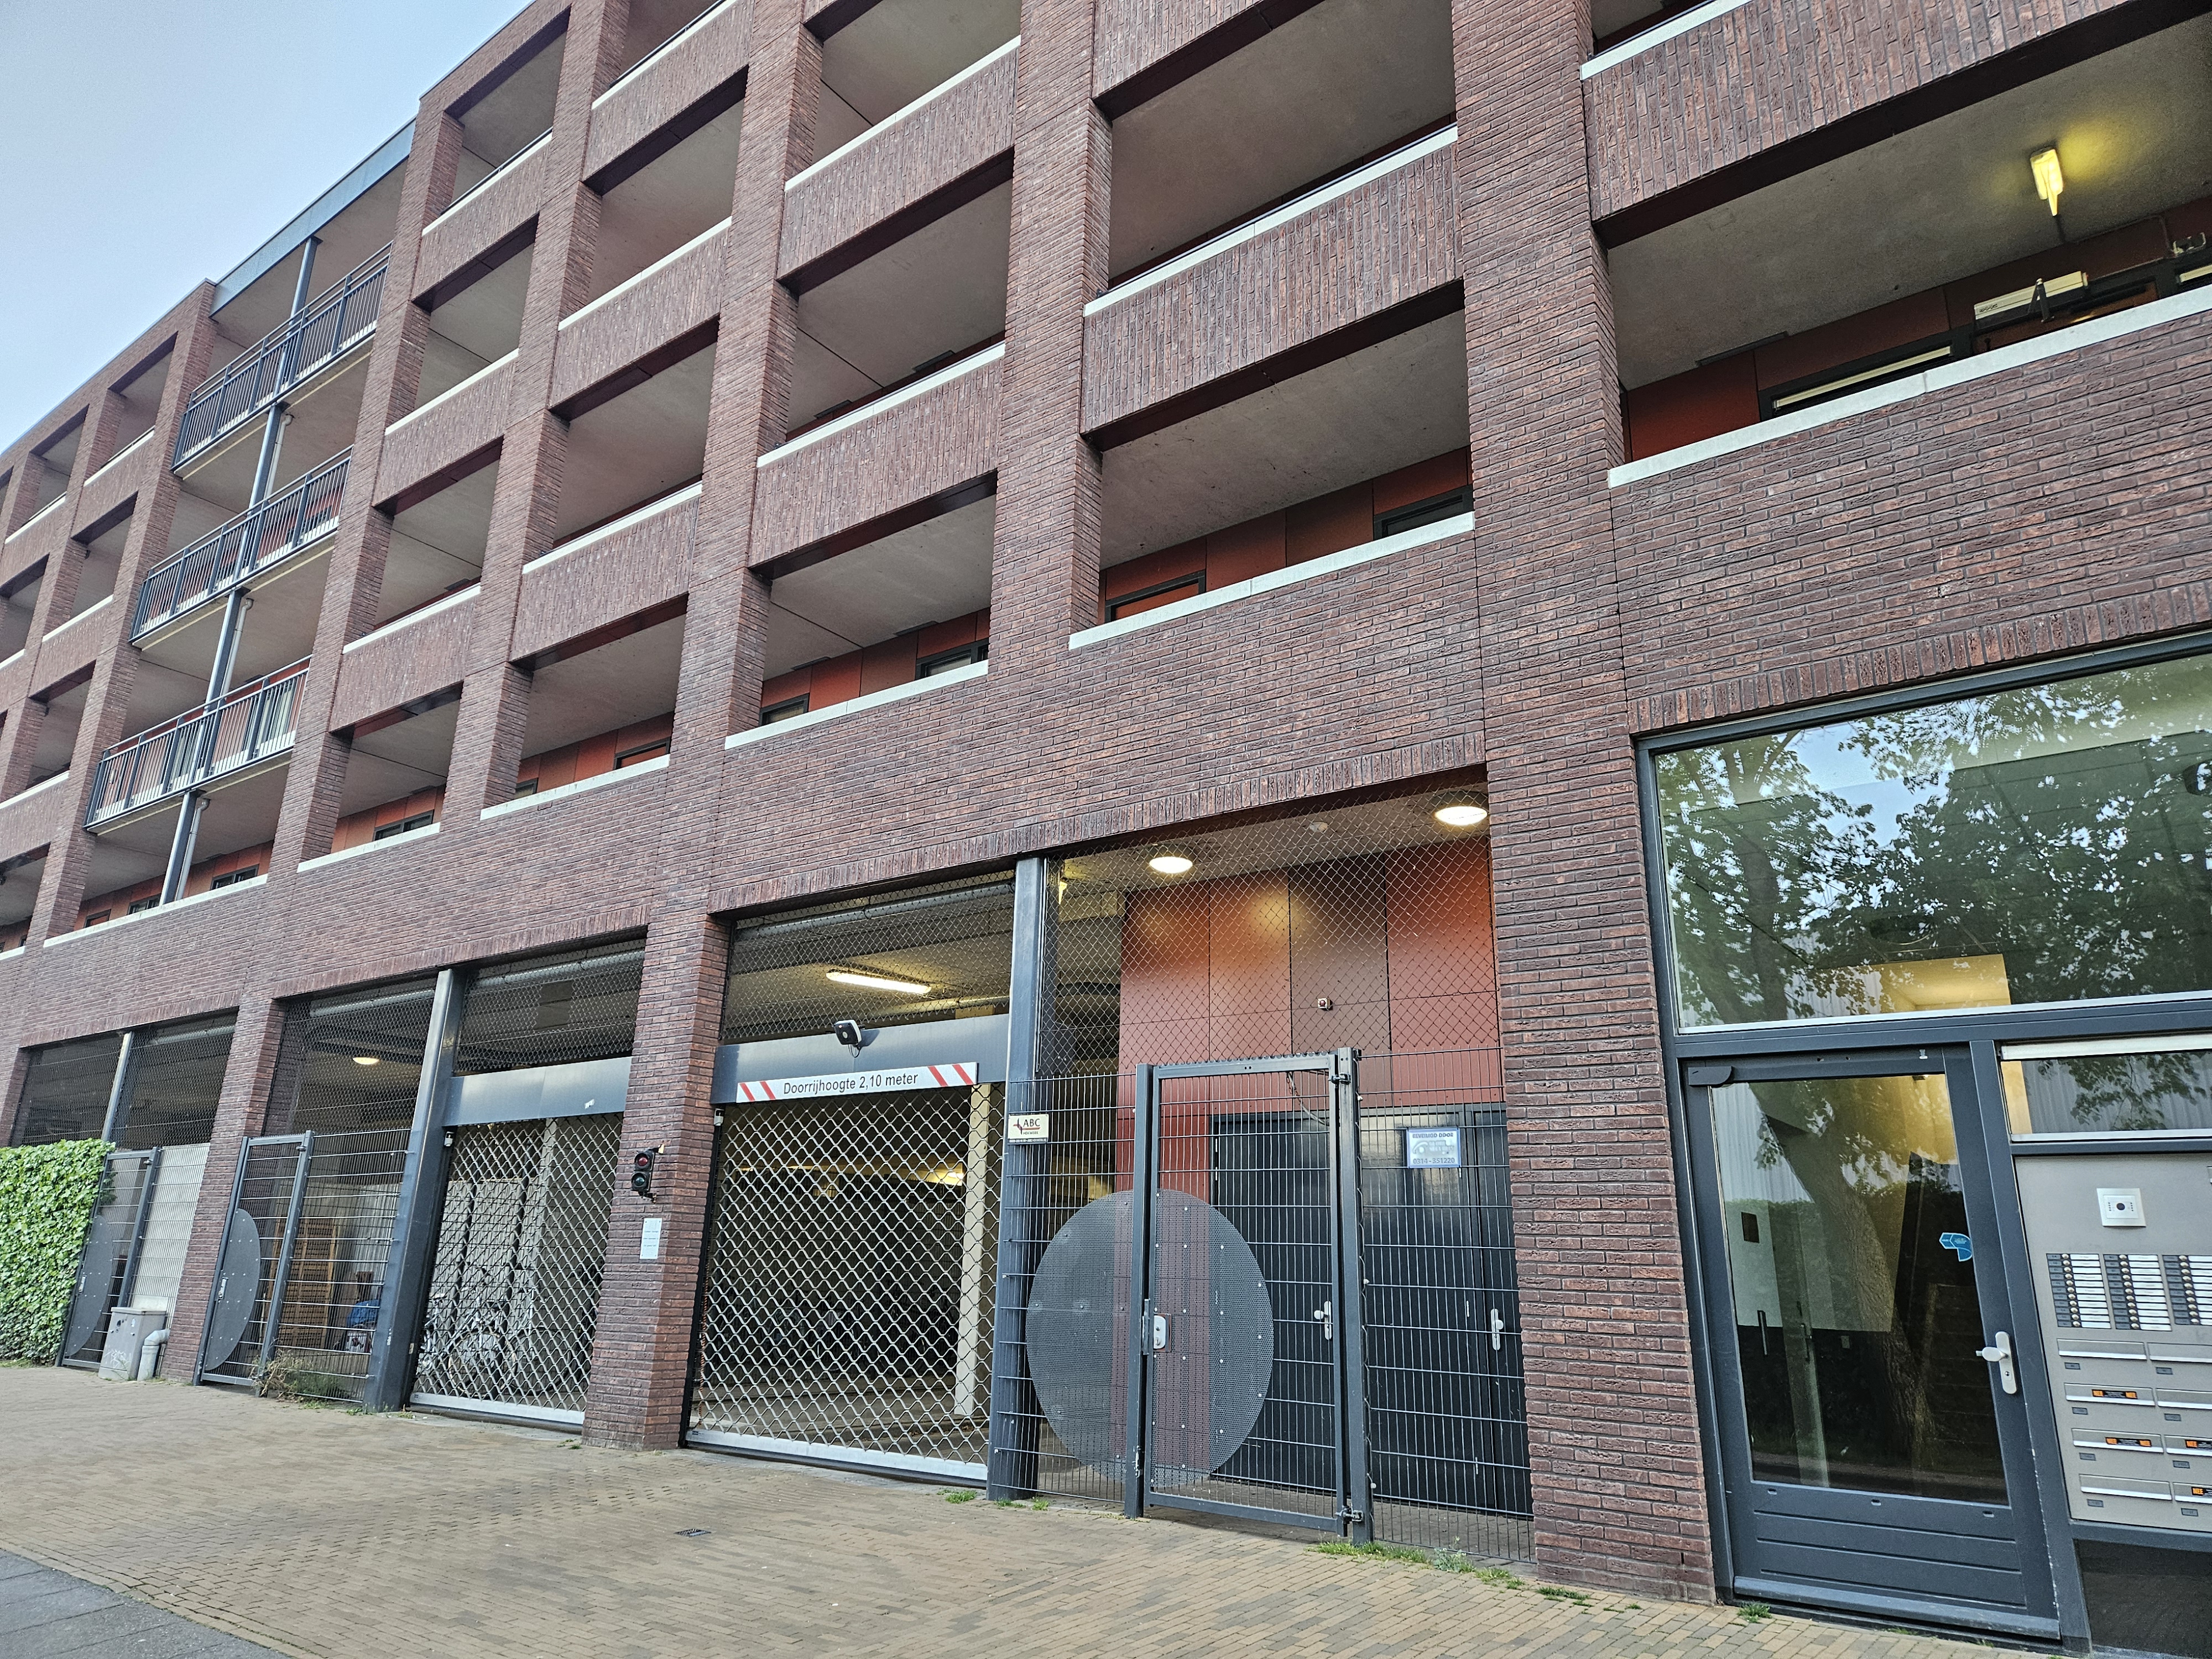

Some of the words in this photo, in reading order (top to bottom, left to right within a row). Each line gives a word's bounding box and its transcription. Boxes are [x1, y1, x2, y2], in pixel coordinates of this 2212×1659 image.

[784, 1078, 855, 1094] Doorrijhoogte
[859, 1074, 881, 1090] 2,10
[885, 1073, 918, 1086] meter
[1023, 1118, 1040, 1127] ABC
